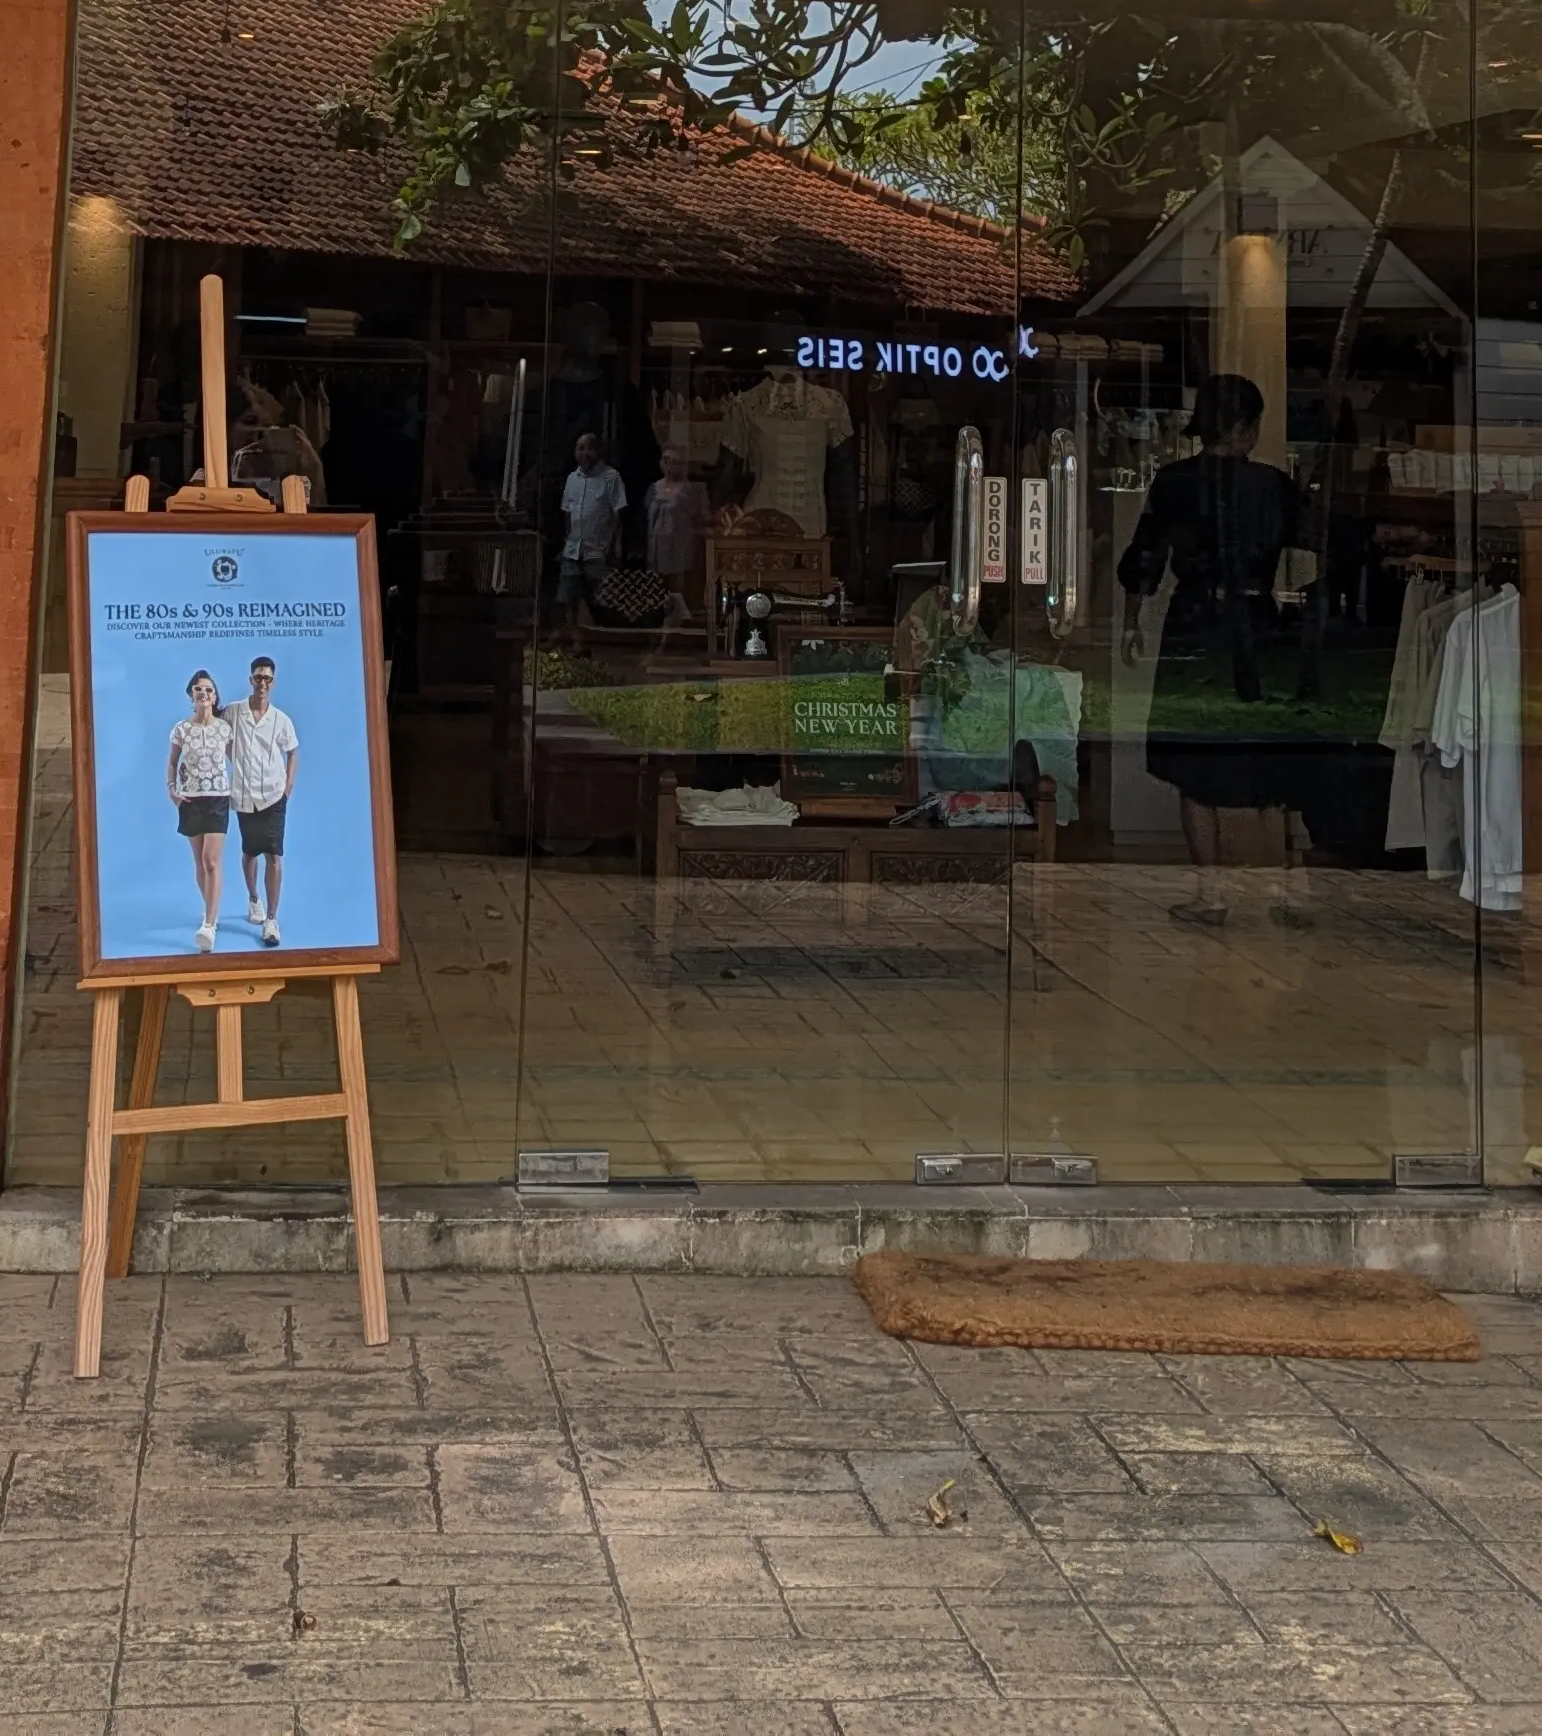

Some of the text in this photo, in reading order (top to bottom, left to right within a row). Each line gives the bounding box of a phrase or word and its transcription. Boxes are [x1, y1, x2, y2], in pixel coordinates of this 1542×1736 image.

[987, 481, 1002, 562] DORONG
[1028, 483, 1042, 564] TARIK
[983, 565, 1004, 577] PUSH
[1025, 567, 1044, 580] PULL
[104, 602, 346, 620] THE 80s & 90s REIMAGINED
[107, 622, 150, 631] DISCOVER
[152, 621, 171, 630] OUR
[174, 621, 209, 629] NEWEST
[211, 620, 265, 629] COLLECTION
[273, 620, 303, 628] WHERE
[305, 619, 346, 628] HERITAGE
[135, 629, 324, 640] CRAFTSMANSHIP REDEFINES TIMELESS STYLE
[794, 701, 897, 718] CHRISTMAS
[795, 718, 898, 735] NEW YEAR
